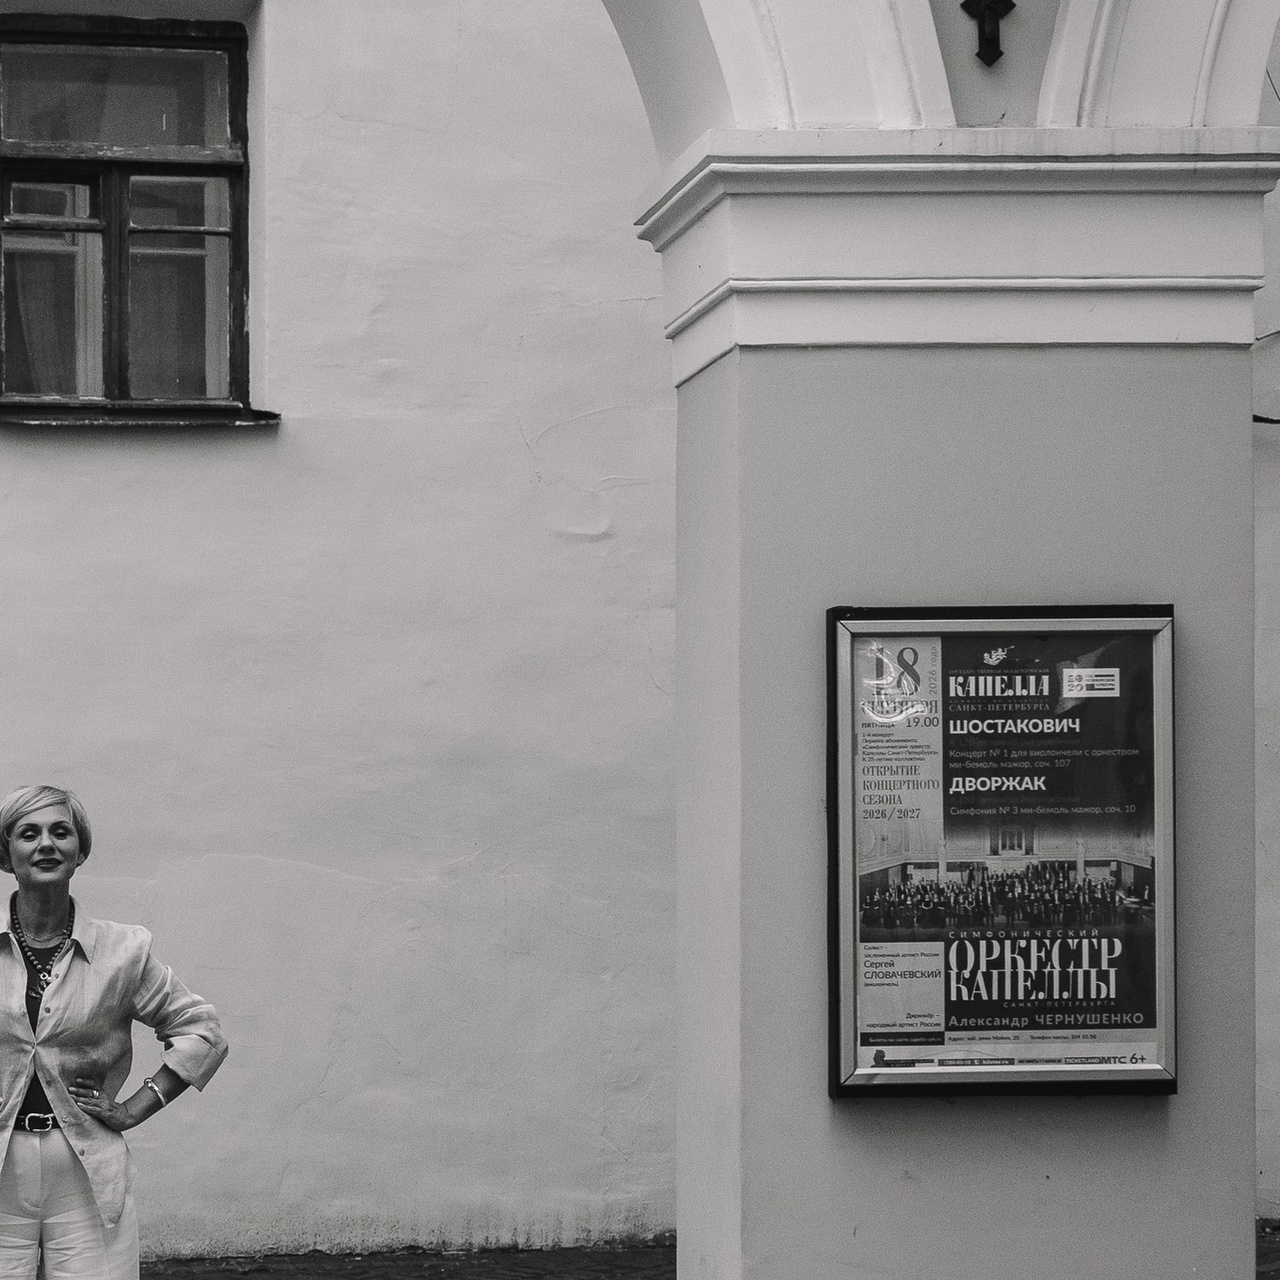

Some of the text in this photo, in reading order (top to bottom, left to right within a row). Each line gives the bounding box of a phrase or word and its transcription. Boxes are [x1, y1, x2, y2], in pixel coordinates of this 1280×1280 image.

[928, 669, 938, 695] 2026
[949, 675, 1049, 696] КАПЕЛЛА
[949, 704, 1050, 712] САНКТ-ПЕТЕРБУРГА
[906, 716, 940, 728] 19.00
[949, 718, 1080, 734] ШОСТАКОВИЧ
[949, 749, 987, 758] Концерт
[1010, 749, 1028, 758] для
[1029, 748, 1082, 756] виолончели
[1091, 748, 1139, 757] оркестром
[949, 759, 1071, 769] ми-бемоль мажор, соч. 107
[862, 765, 920, 776] ОТКРЫТИЕ
[862, 779, 940, 791] КОНЦЕРТНОГО
[949, 776, 1047, 795] ДВОРЖАК
[862, 794, 903, 805] СЕЗОНА
[950, 806, 997, 816] Симфония
[1012, 806, 1019, 814] 3
[1020, 805, 1069, 814] ми-бемоль
[1071, 806, 1104, 815] мажор,
[1124, 804, 1136, 813] 10
[948, 928, 1099, 939] СИМФОНИЧЕСКИЙ
[948, 938, 1122, 972] ОРКЕСТР
[863, 960, 895, 969] Сергей
[863, 969, 941, 979] СЛОВАЧЕВСКИЙ
[948, 968, 1118, 1001] КАПЕЛЛЫ
[948, 1013, 1144, 1027] Александр ЧЕРНУШЕНКО
[1130, 1053, 1146, 1064] 6+
